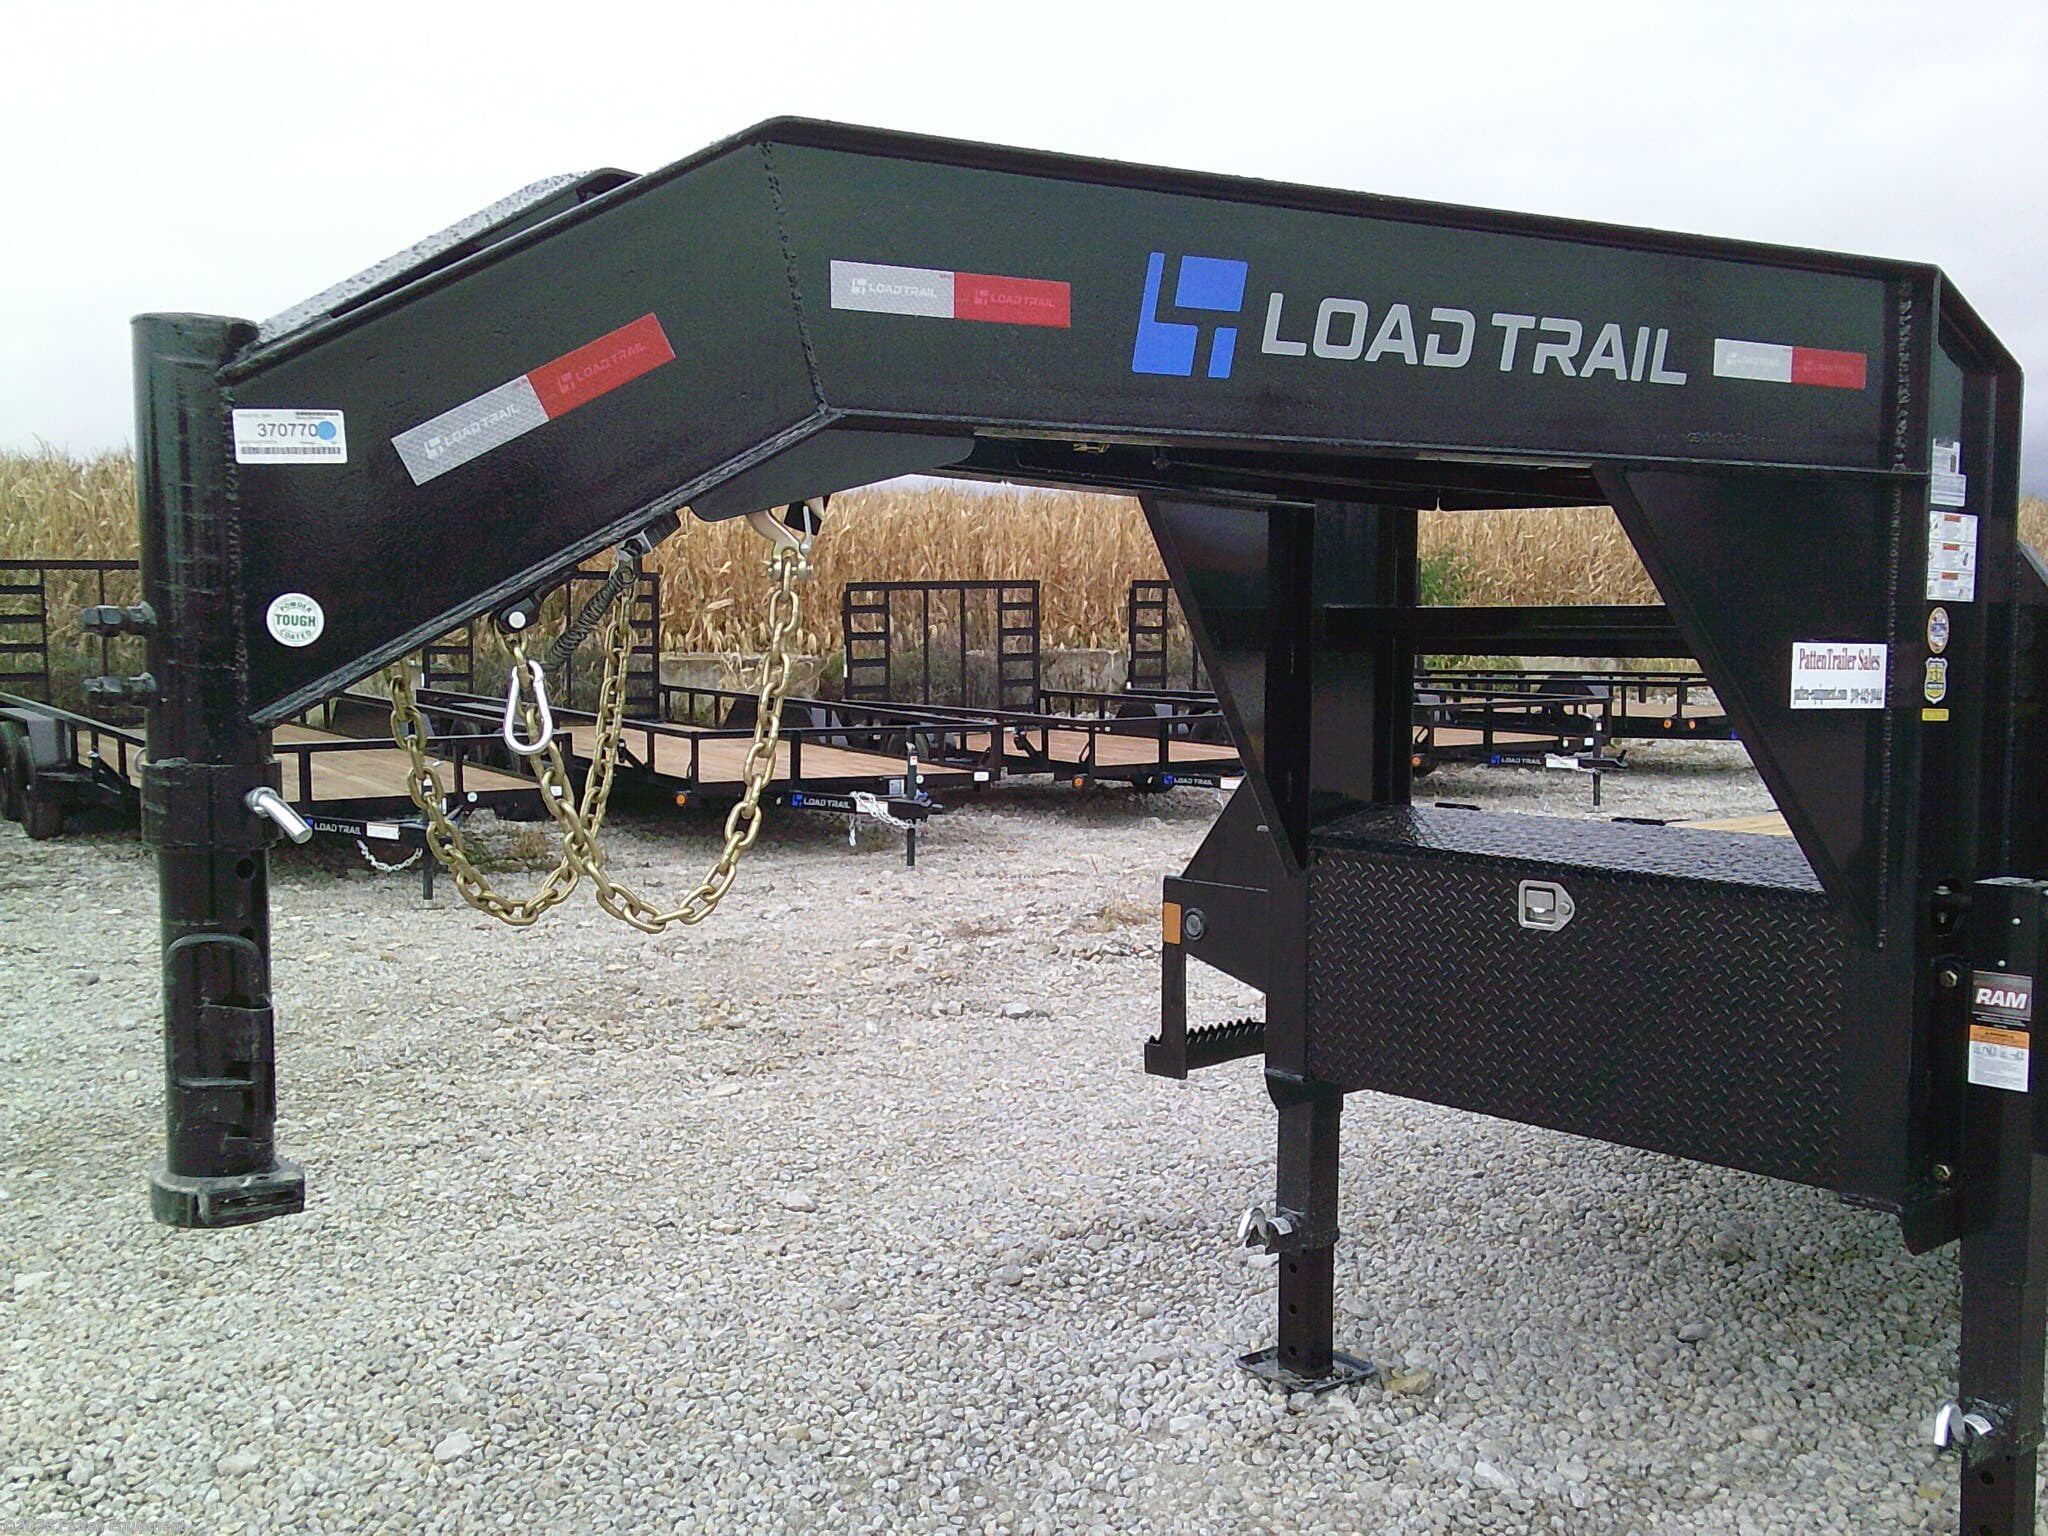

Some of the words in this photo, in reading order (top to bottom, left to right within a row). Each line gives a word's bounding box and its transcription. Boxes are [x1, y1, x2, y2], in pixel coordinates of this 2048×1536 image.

[869, 283, 902, 296] LOAD
[903, 286, 937, 299] TRAIL
[991, 294, 1021, 305] LOAD
[1022, 296, 1056, 308] TRAIL
[1261, 292, 1477, 369] LOAD
[1490, 313, 1688, 386] TRAIL
[575, 358, 610, 382] LOAD
[608, 342, 647, 366] TRAIL
[257, 422, 318, 437] 370770
[443, 422, 480, 448] LOAD
[479, 404, 519, 430] TRAIL
[274, 613, 316, 627] TOUGH
[279, 628, 312, 640] COATED
[1799, 648, 1827, 670] Patten
[1827, 647, 1857, 671] Trailer
[1858, 648, 1881, 671] Sales
[803, 797, 826, 807] LOAD
[827, 799, 851, 809] TRAIL
[314, 822, 338, 832] LOAD
[338, 824, 362, 835] TRAIL
[1975, 987, 2029, 1010] RAM
